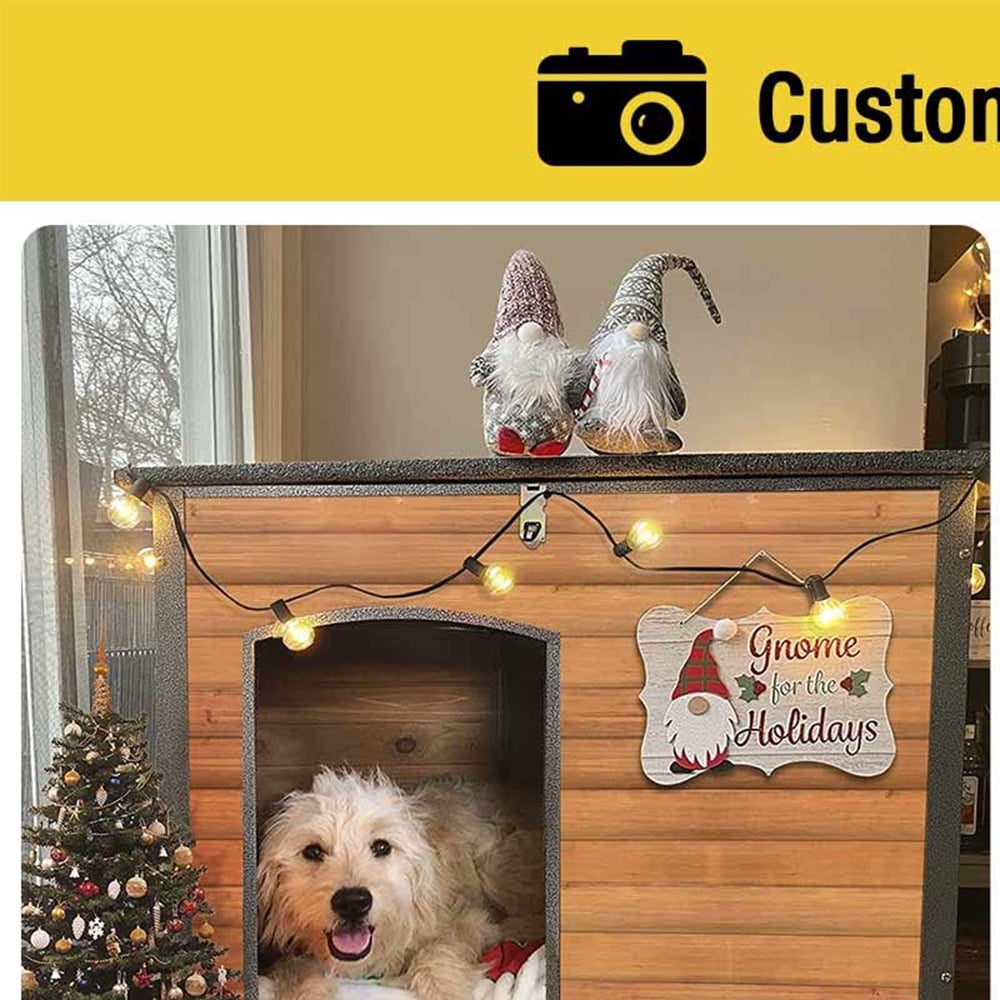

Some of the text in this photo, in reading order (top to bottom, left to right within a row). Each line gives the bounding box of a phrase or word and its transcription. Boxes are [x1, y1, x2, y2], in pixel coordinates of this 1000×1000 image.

[749, 624, 861, 676] Gnome
[771, 670, 837, 705] for the
[734, 706, 878, 757] Holidays
